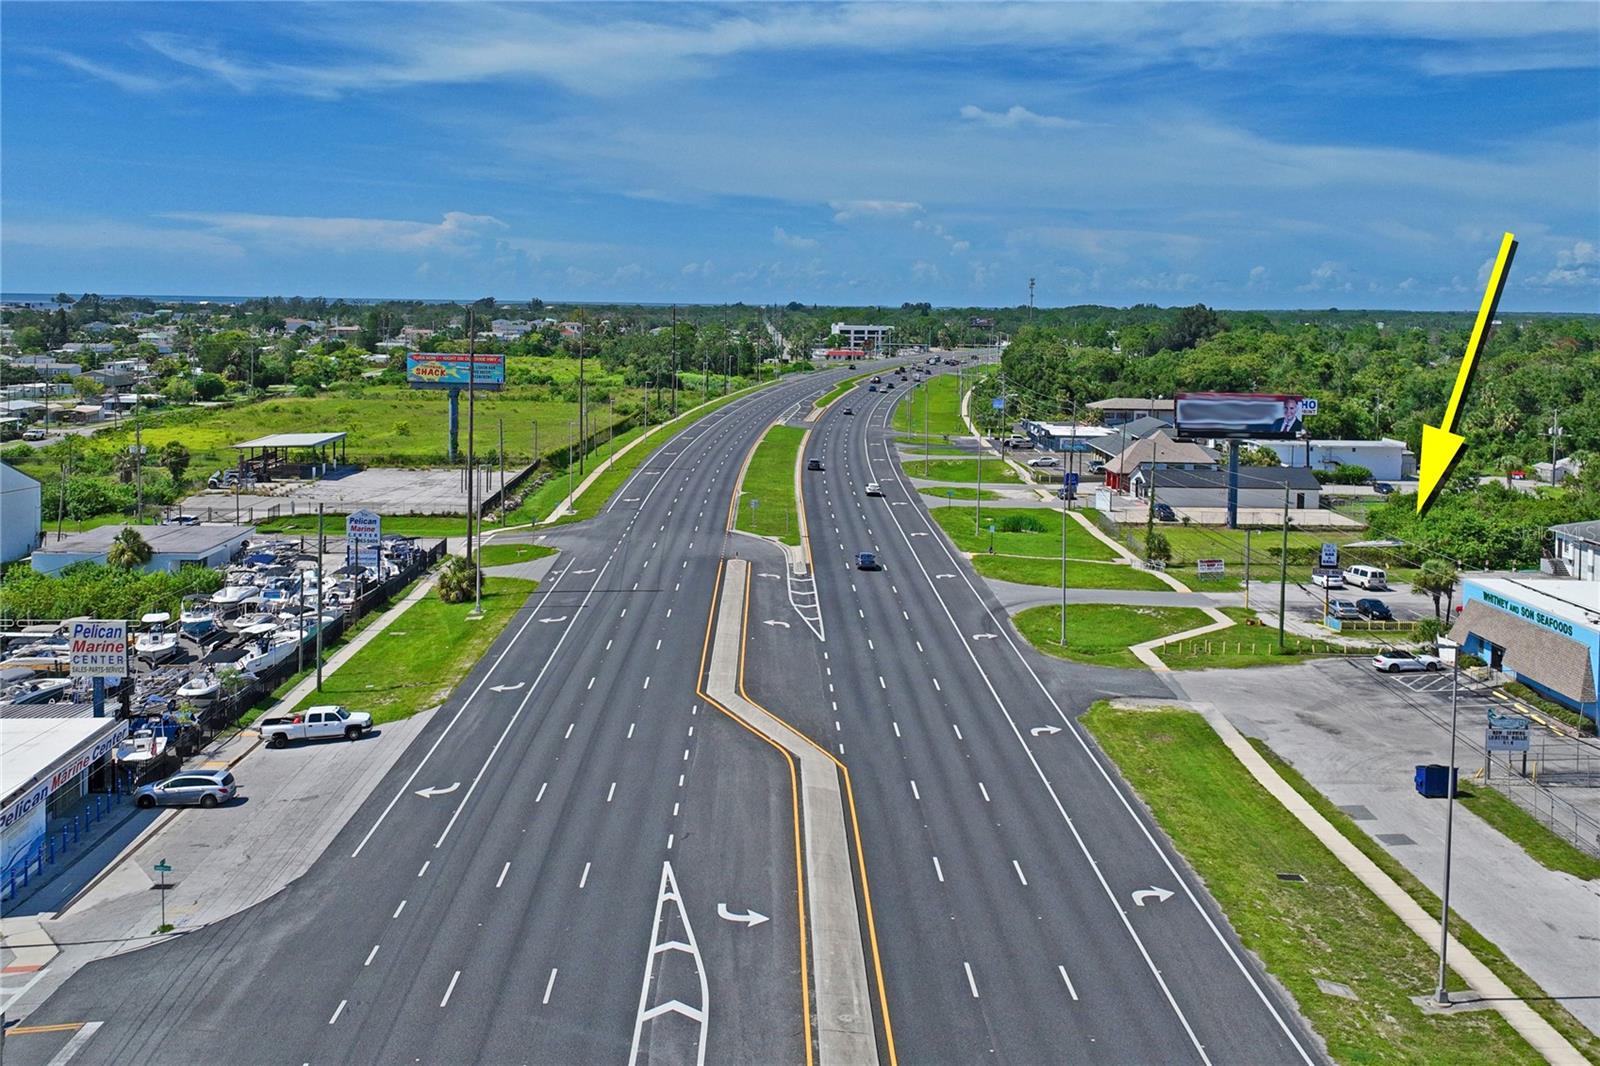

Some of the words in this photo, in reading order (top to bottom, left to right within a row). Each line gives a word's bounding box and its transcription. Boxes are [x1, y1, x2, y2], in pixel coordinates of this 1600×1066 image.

[415, 367, 446, 376] SHACK
[1483, 591, 1508, 609] WHITNEY
[1509, 604, 1519, 614] AND
[1521, 606, 1534, 620] SON
[1536, 612, 1573, 636] SEAFOODS
[73, 623, 122, 638] Pelican
[72, 640, 124, 653] Marine
[73, 655, 124, 664] CENTER
[51, 757, 90, 791] Marine
[92, 728, 128, 760] Center
